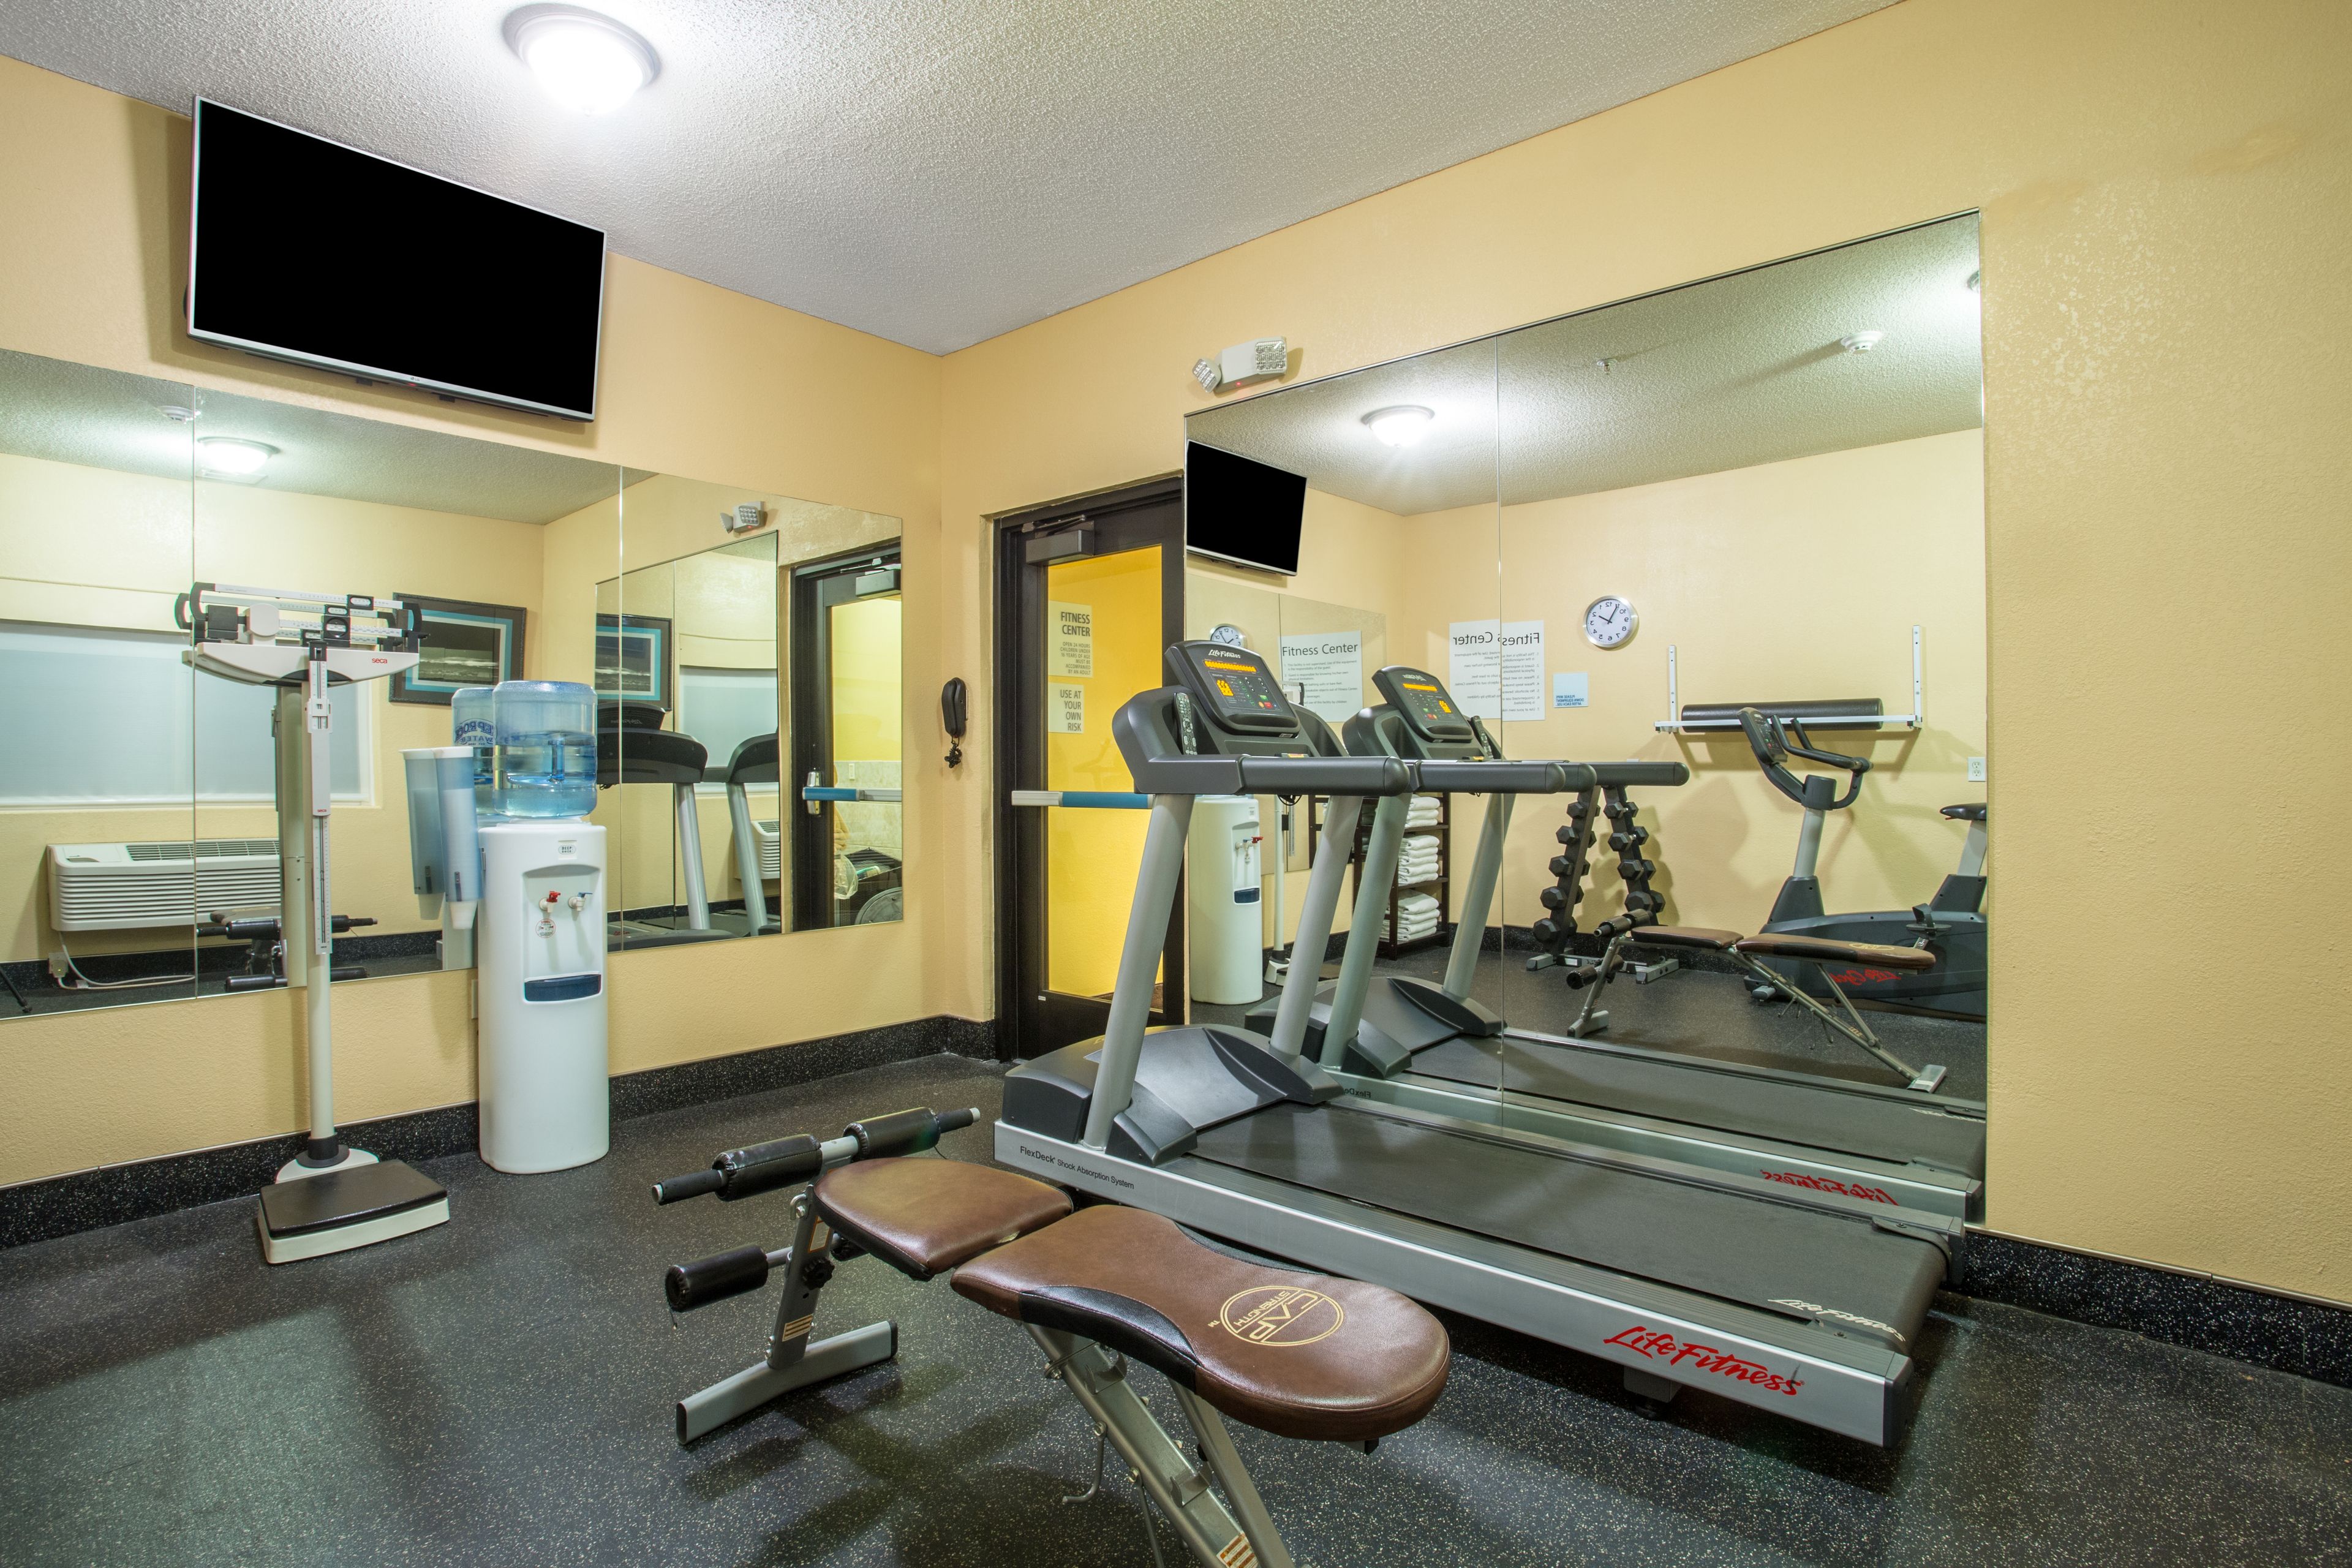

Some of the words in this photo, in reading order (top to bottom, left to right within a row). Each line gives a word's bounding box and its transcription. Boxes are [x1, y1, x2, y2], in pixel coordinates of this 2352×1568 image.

[1061, 611, 1090, 624] FITNESS
[1062, 625, 1090, 637] CENTER
[1283, 647, 1318, 656] Fitness
[1322, 644, 1358, 654] Center
[1060, 689, 1072, 698] USE
[1064, 701, 1082, 710] YOUR
[1066, 712, 1081, 721] OWN
[1068, 722, 1082, 731] RISK
[1057, 1159, 1076, 1171] Shock
[1077, 1166, 1110, 1182] Absorption
[1110, 1176, 1134, 1189] System
[1233, 1291, 1291, 1327] STRENGTH
[1249, 1292, 1319, 1340] CAP
